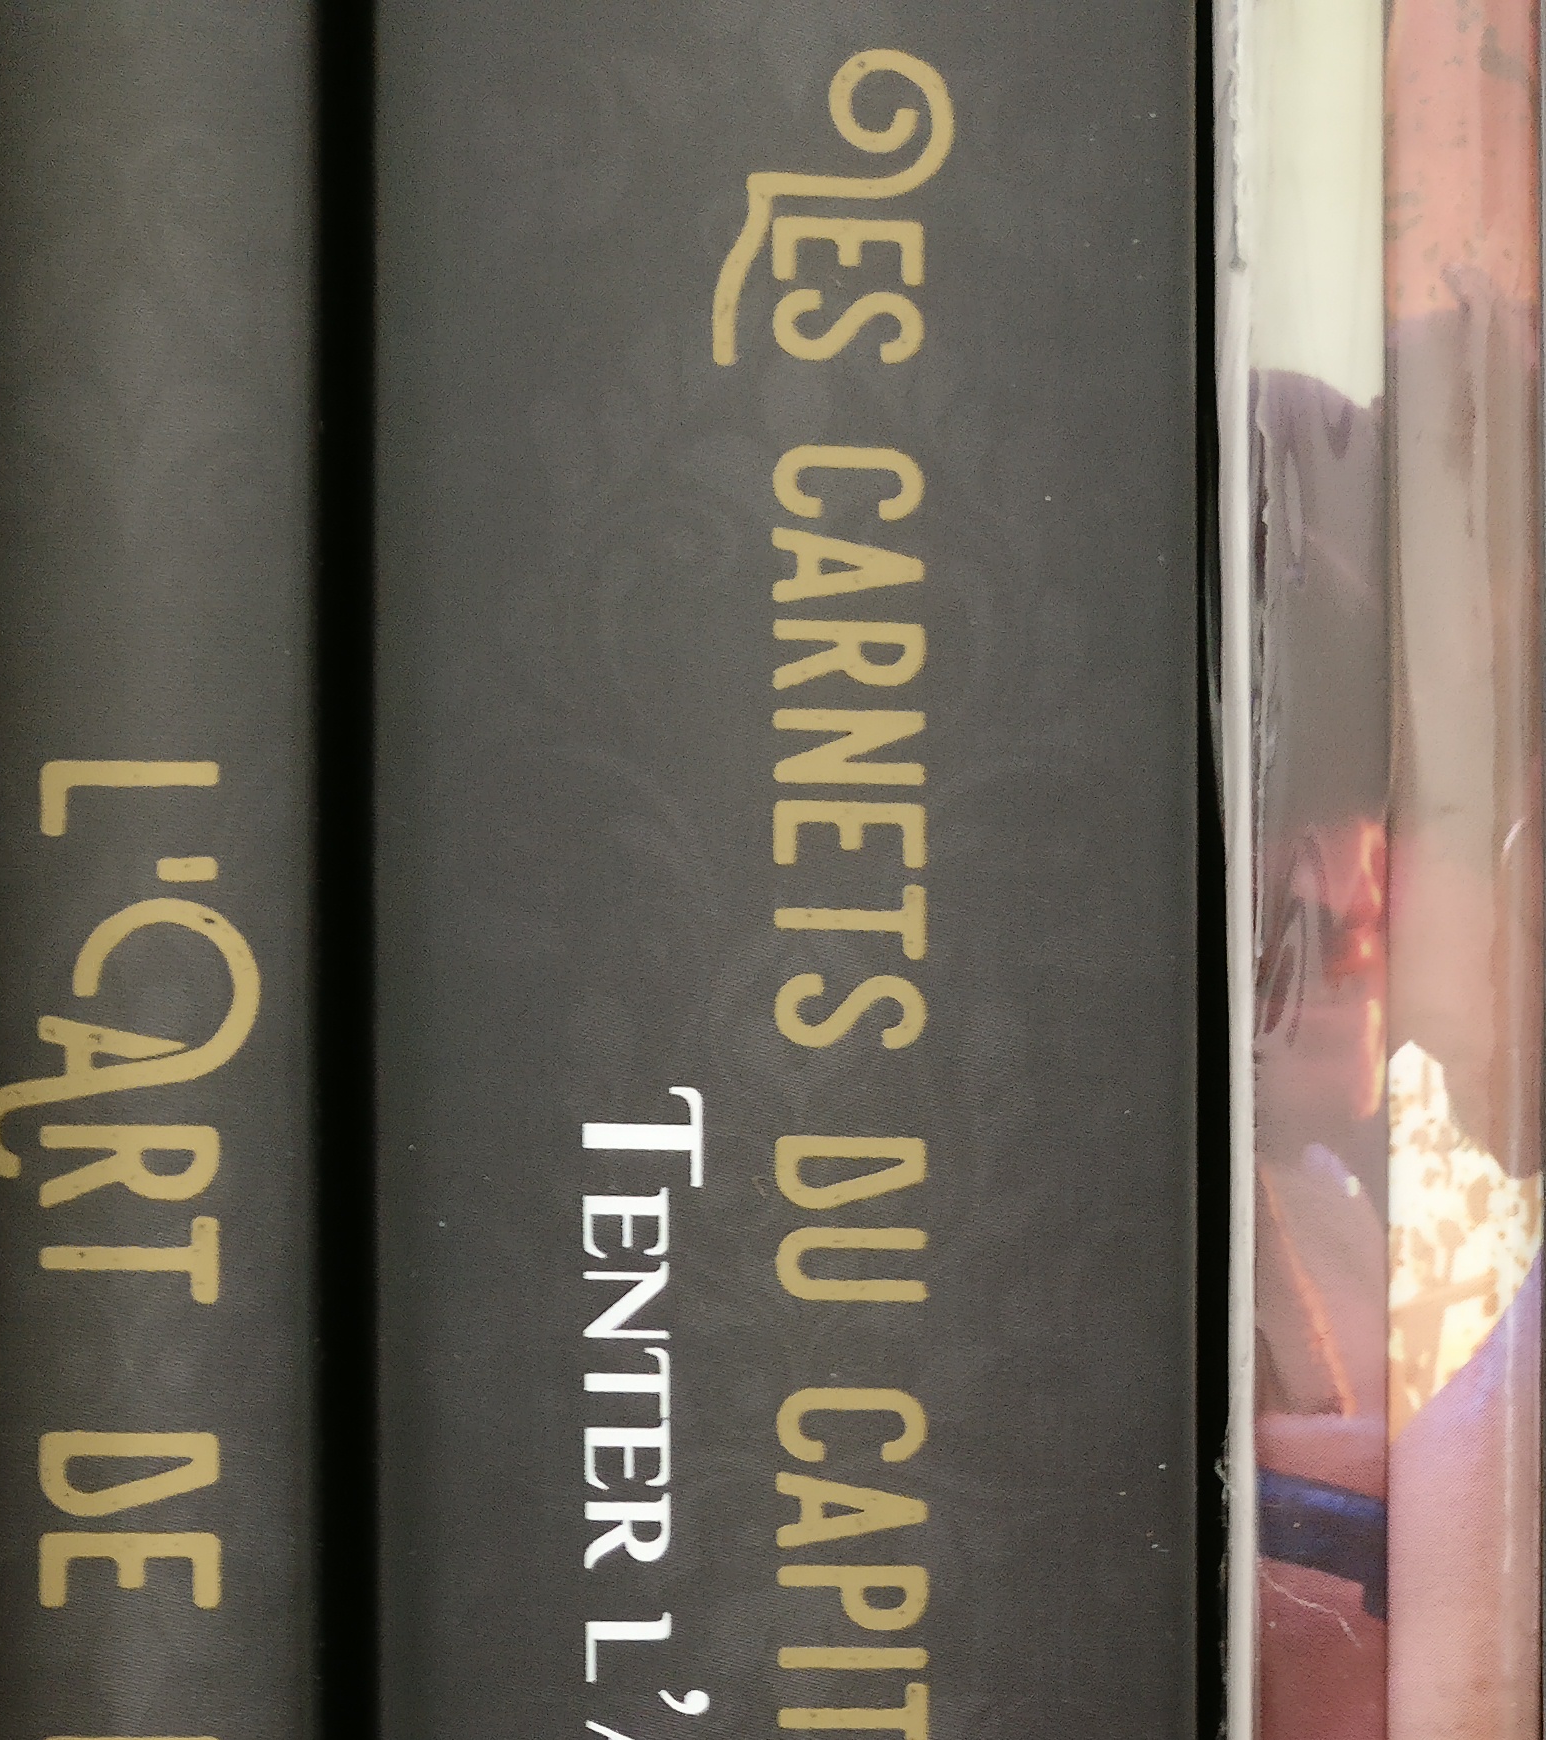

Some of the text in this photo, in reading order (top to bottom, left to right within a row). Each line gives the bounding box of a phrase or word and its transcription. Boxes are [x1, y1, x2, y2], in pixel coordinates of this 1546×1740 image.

[711, 47, 957, 368] LES
[771, 442, 929, 1051] CARNETS
[580, 1085, 706, 1571] TENTER
[772, 1134, 930, 1305] DU
[37, 1428, 224, 1612] DE
